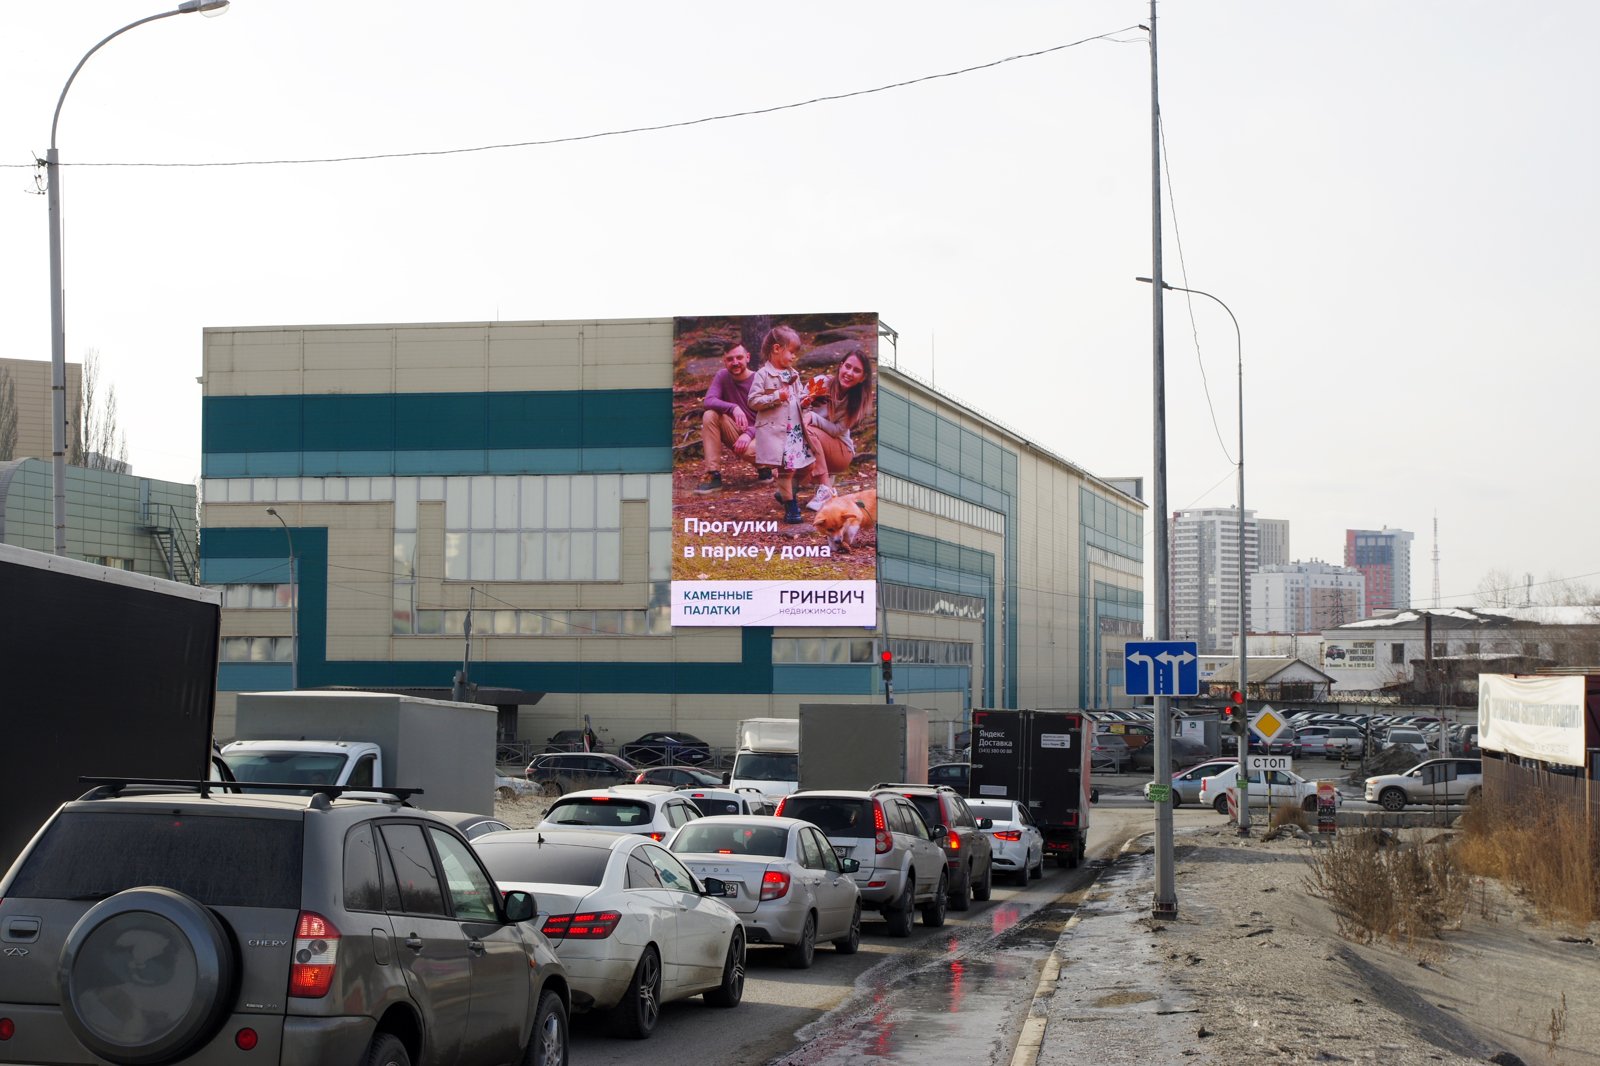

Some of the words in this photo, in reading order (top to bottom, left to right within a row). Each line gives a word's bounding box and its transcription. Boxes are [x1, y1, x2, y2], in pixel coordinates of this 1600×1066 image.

[684, 517, 778, 536] Прогулки
[684, 546, 695, 558] в
[701, 546, 759, 561] парке
[763, 546, 775, 561] у
[780, 545, 831, 559] дома
[683, 590, 753, 600] КАМЕННЫЕ
[779, 590, 865, 604] ГРИНВИЧ
[683, 605, 741, 615] ПАЛАТКИ
[779, 607, 847, 615] недвижимость
[979, 729, 1005, 738] Яндекс
[979, 739, 1013, 747] Доставка
[1253, 758, 1286, 768] СТОП
[248, 939, 288, 947] CHERY
